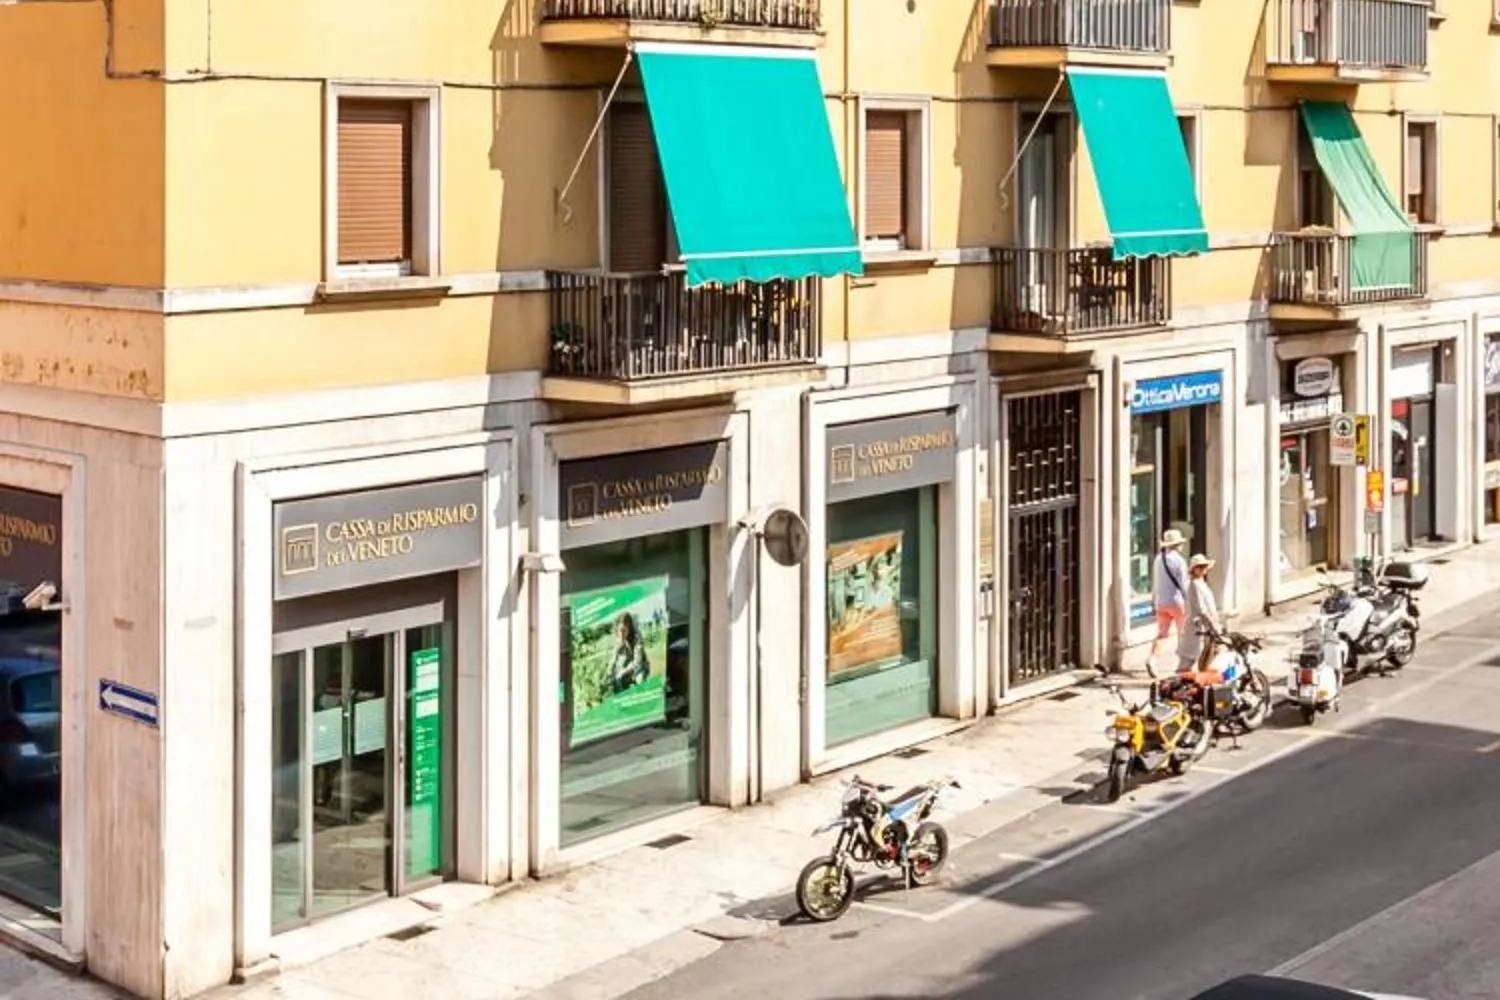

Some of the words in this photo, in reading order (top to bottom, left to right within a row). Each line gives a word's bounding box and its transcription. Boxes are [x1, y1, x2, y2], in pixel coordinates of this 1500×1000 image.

[325, 518, 375, 543] CASSA
[392, 503, 478, 534] RISPARMIO
[347, 535, 413, 562] VENETO
